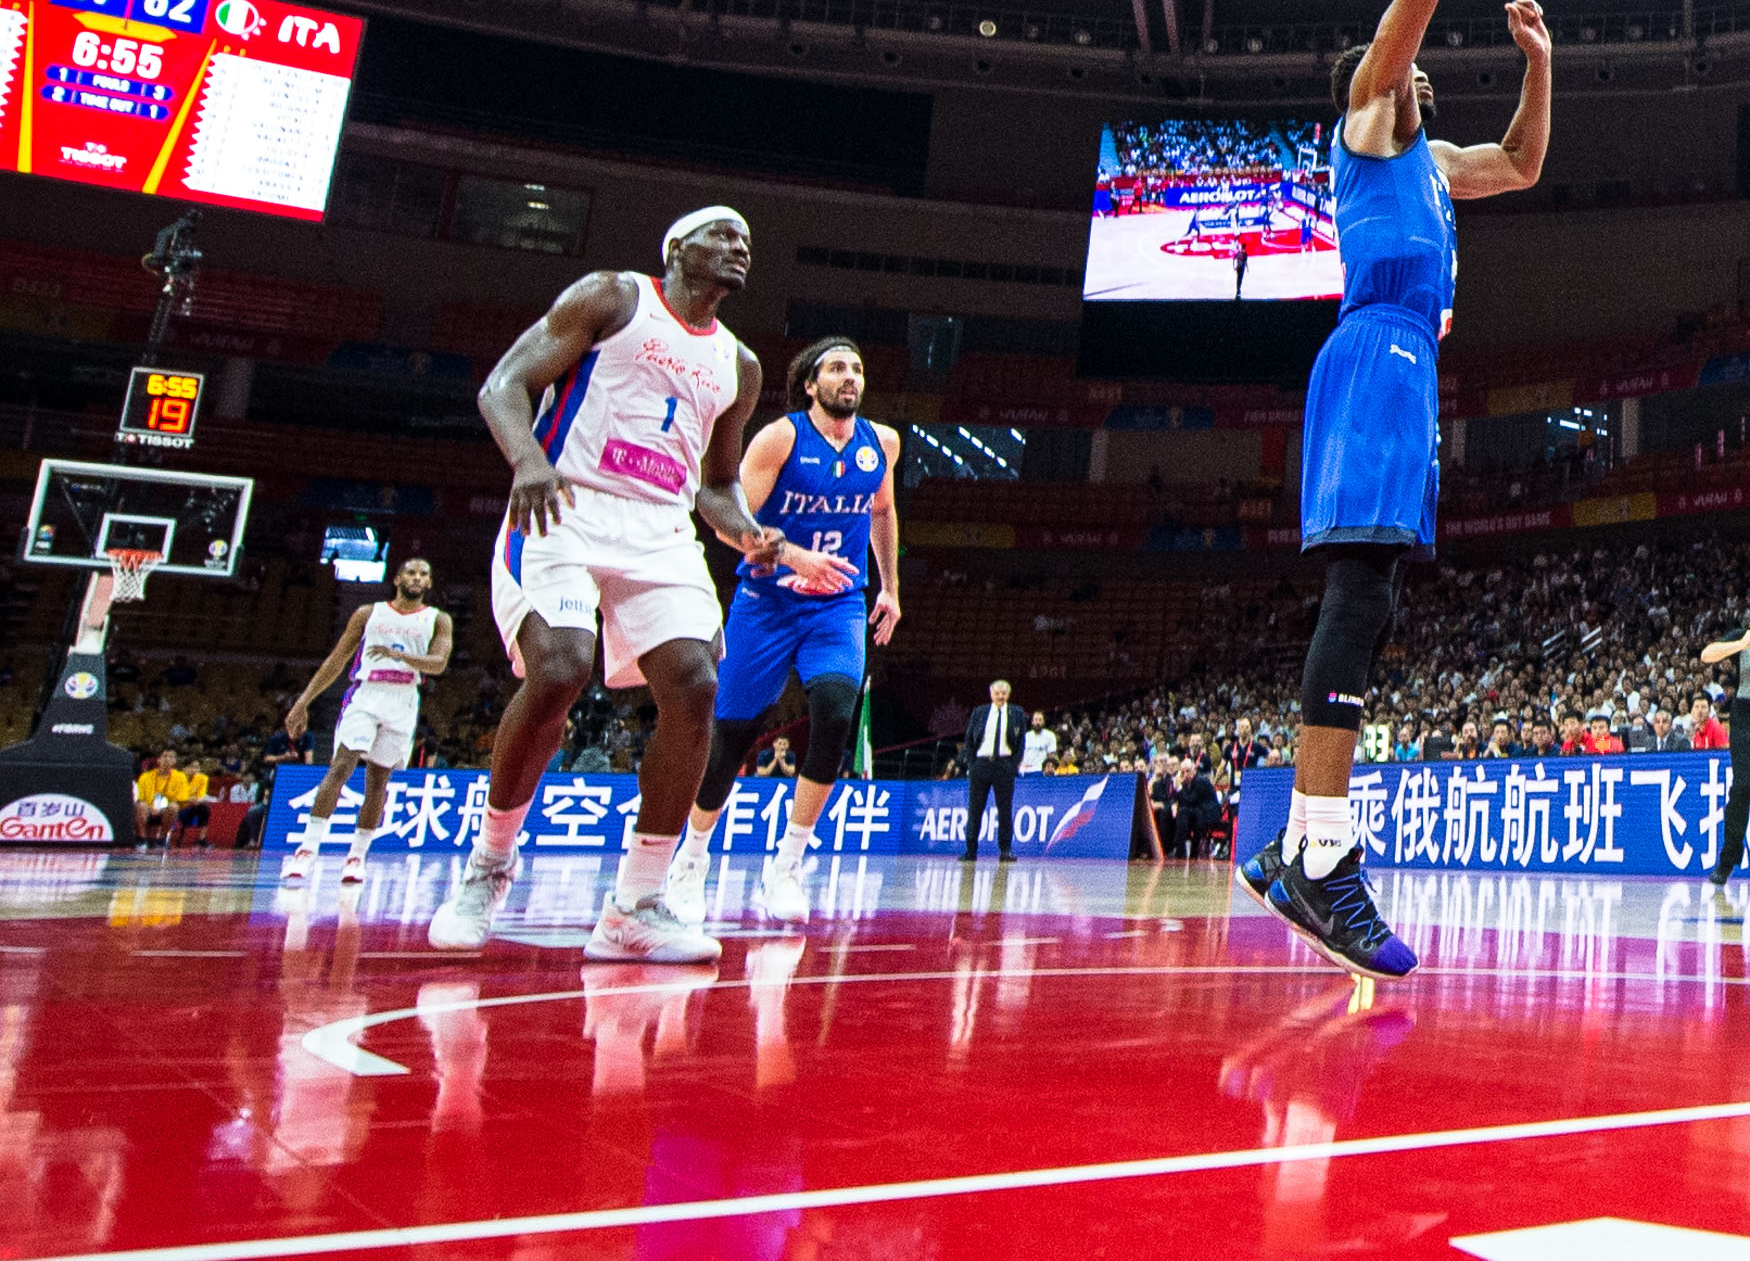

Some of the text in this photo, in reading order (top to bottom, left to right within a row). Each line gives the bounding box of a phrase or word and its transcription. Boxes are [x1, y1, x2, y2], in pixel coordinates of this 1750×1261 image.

[277, 15, 341, 55] ITA
[72, 31, 165, 80] 6:55
[147, 373, 198, 400] 6:55
[147, 397, 191, 434] 19
[660, 395, 679, 433] 1
[137, 433, 195, 450] TISSOT
[779, 490, 876, 515] ITALIA
[811, 529, 843, 557] 12
[18, 802, 86, 818] 百岁山
[919, 805, 1054, 843] AERFOT
